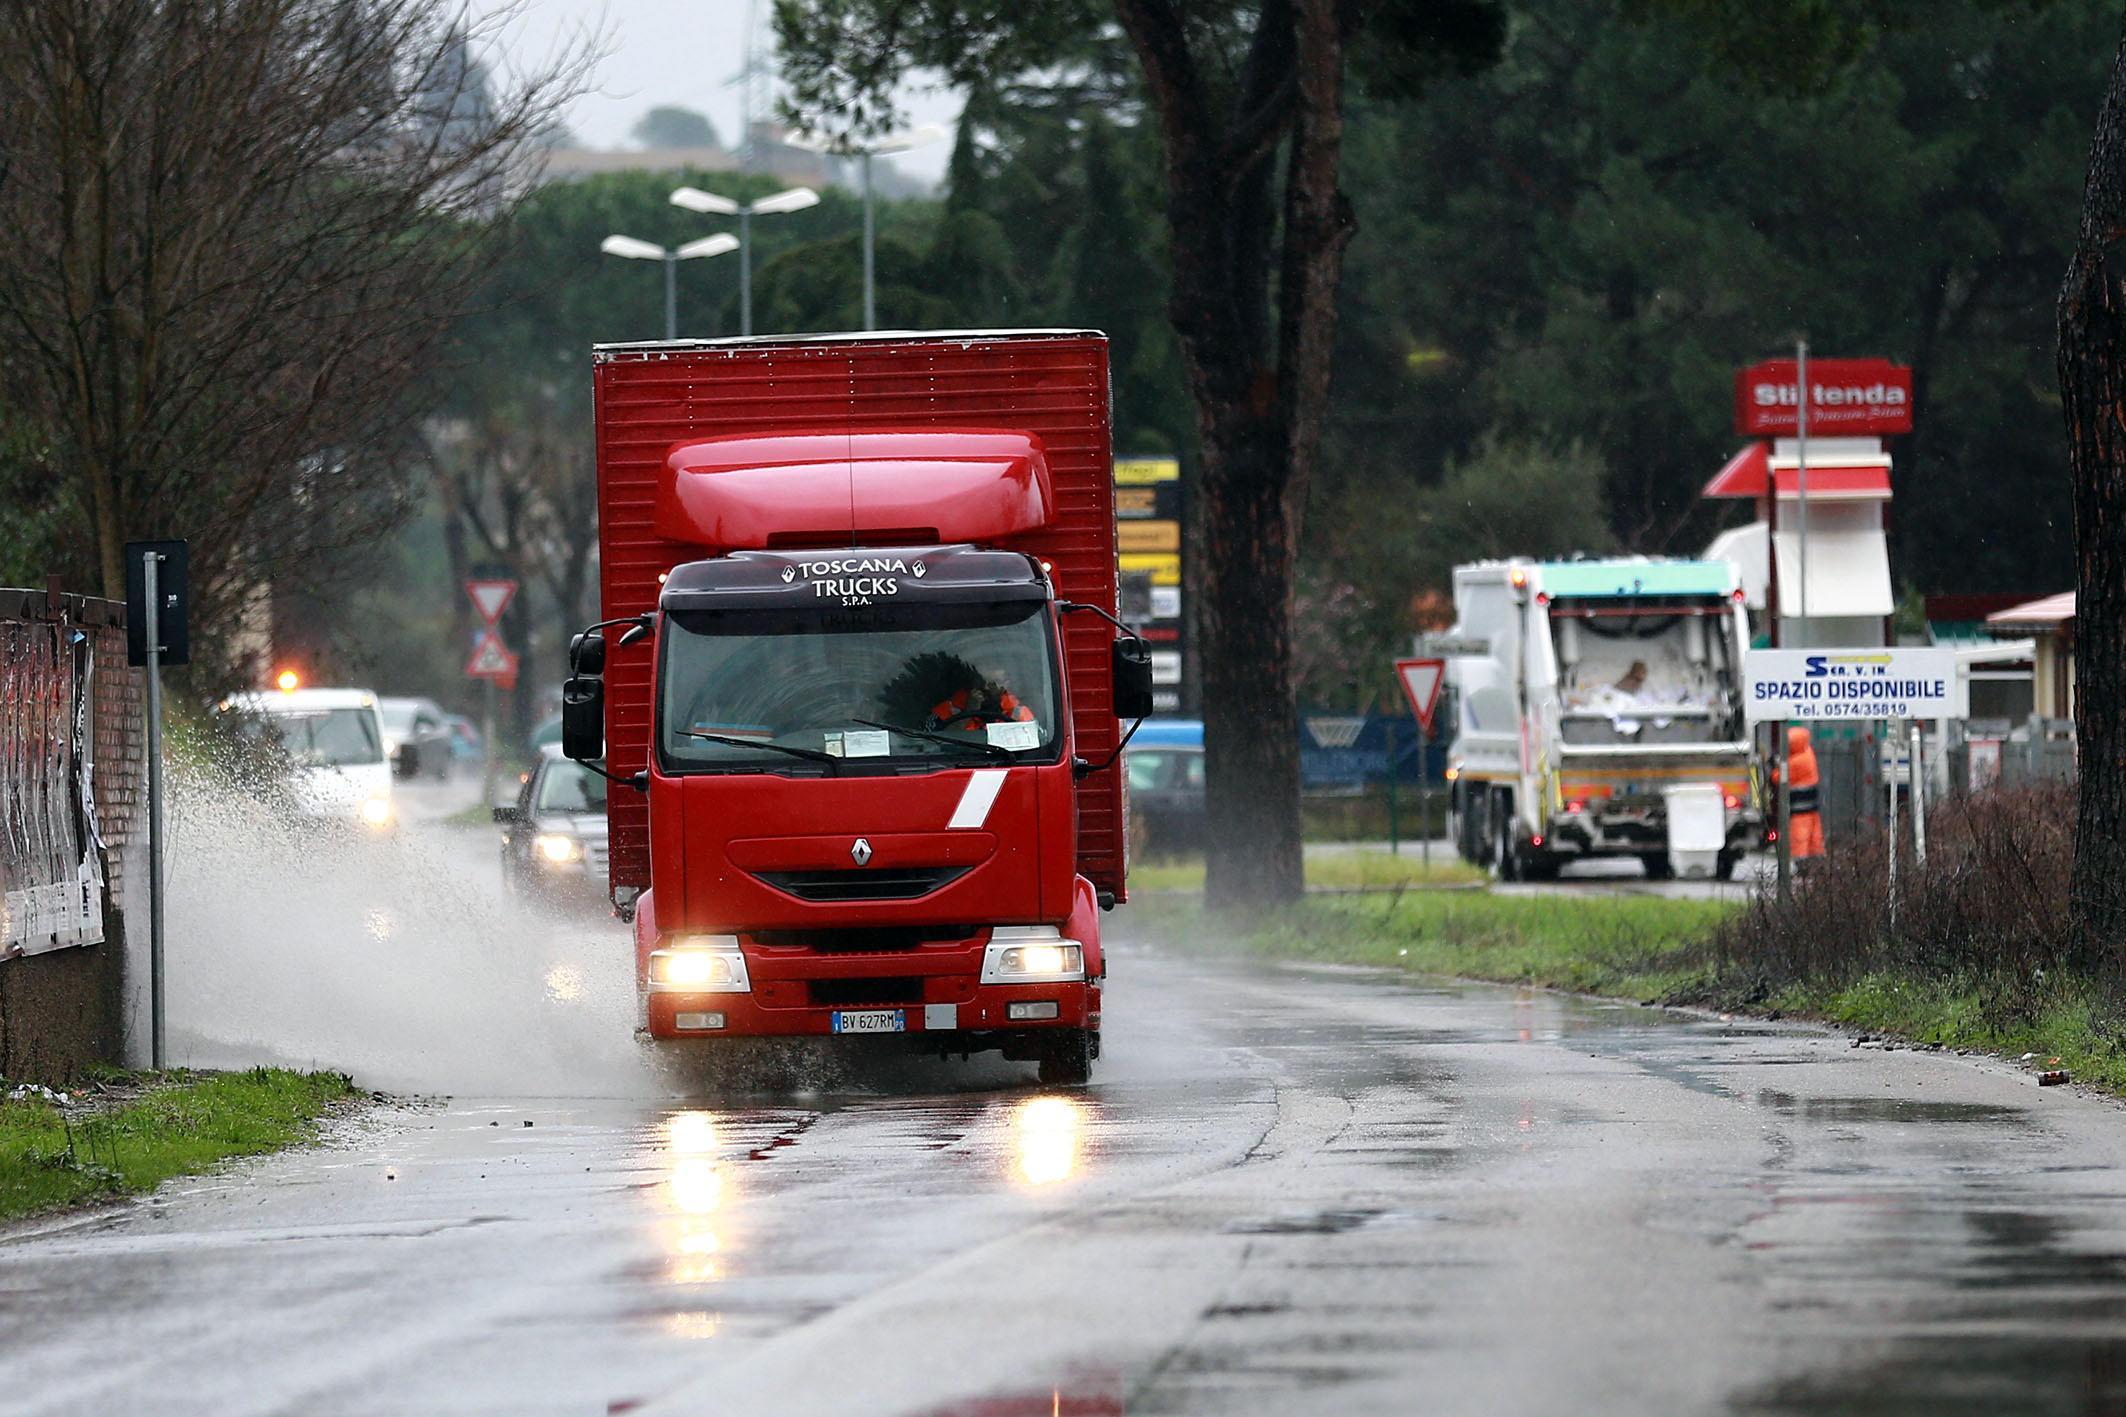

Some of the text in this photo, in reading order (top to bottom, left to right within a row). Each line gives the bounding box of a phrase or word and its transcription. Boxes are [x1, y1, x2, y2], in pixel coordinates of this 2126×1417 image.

[798, 558, 908, 579] TOSCANA
[811, 577, 898, 597] TRUCKS
[841, 596, 873, 607] S.P.A.
[1755, 680, 1946, 700] SPAZIO DISPONIBILE
[1794, 703, 1908, 717] Tel. 0574/35819
[842, 1015, 856, 1030] BV
[859, 1013, 895, 1029] 627RM
